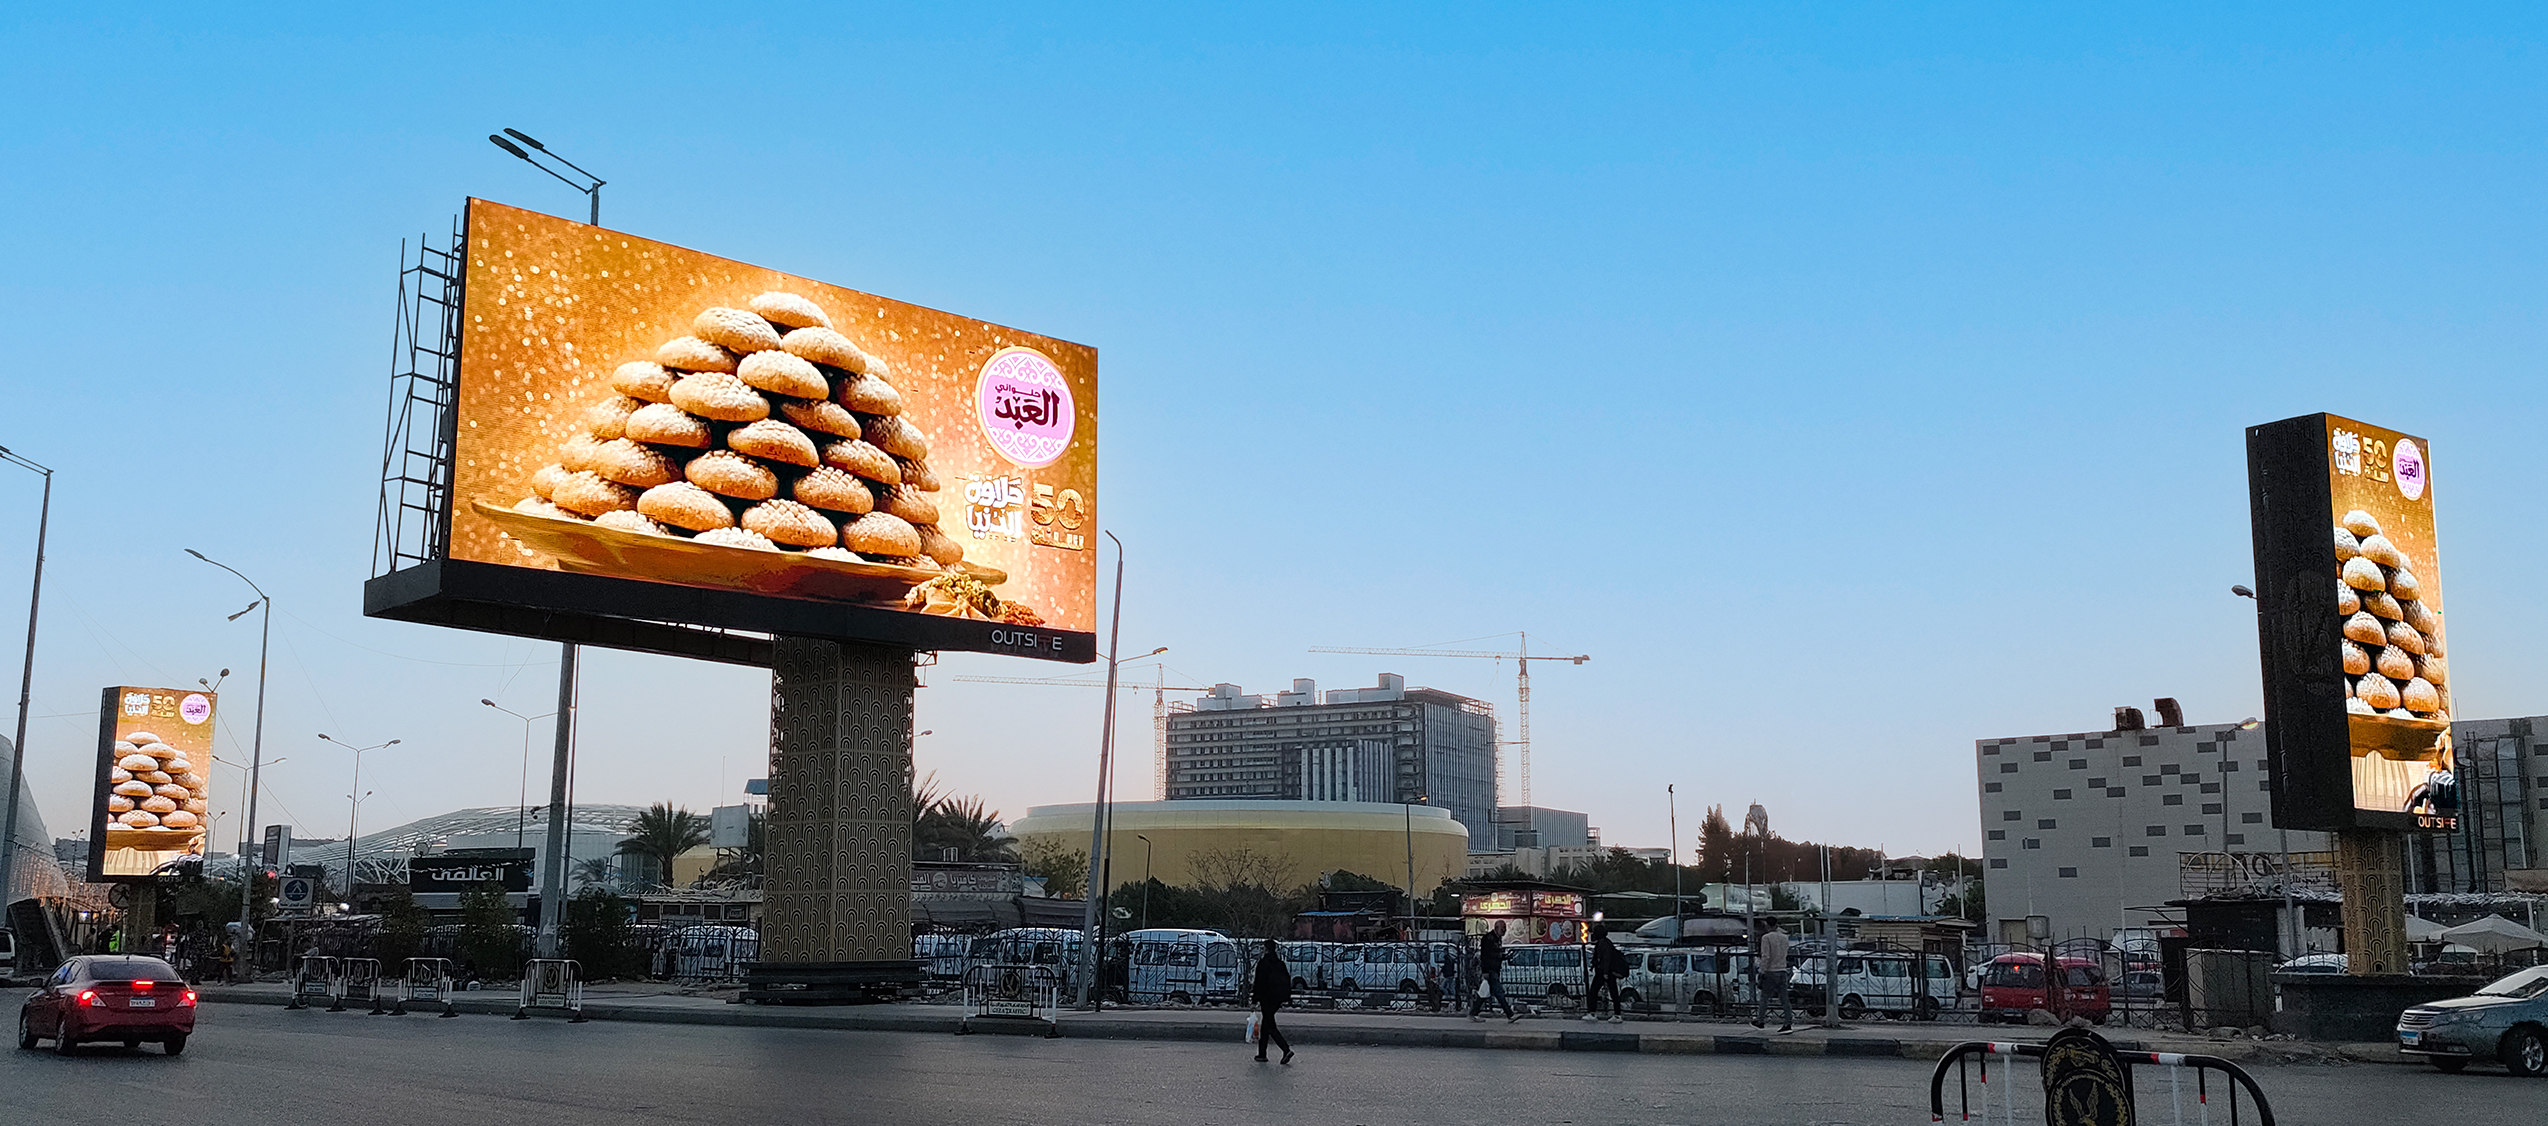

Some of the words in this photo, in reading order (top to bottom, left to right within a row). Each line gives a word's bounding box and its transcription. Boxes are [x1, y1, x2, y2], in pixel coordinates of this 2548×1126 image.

[2363, 436, 2388, 469] 50
[1030, 482, 1085, 531] 50
[152, 695, 176, 711] 50
